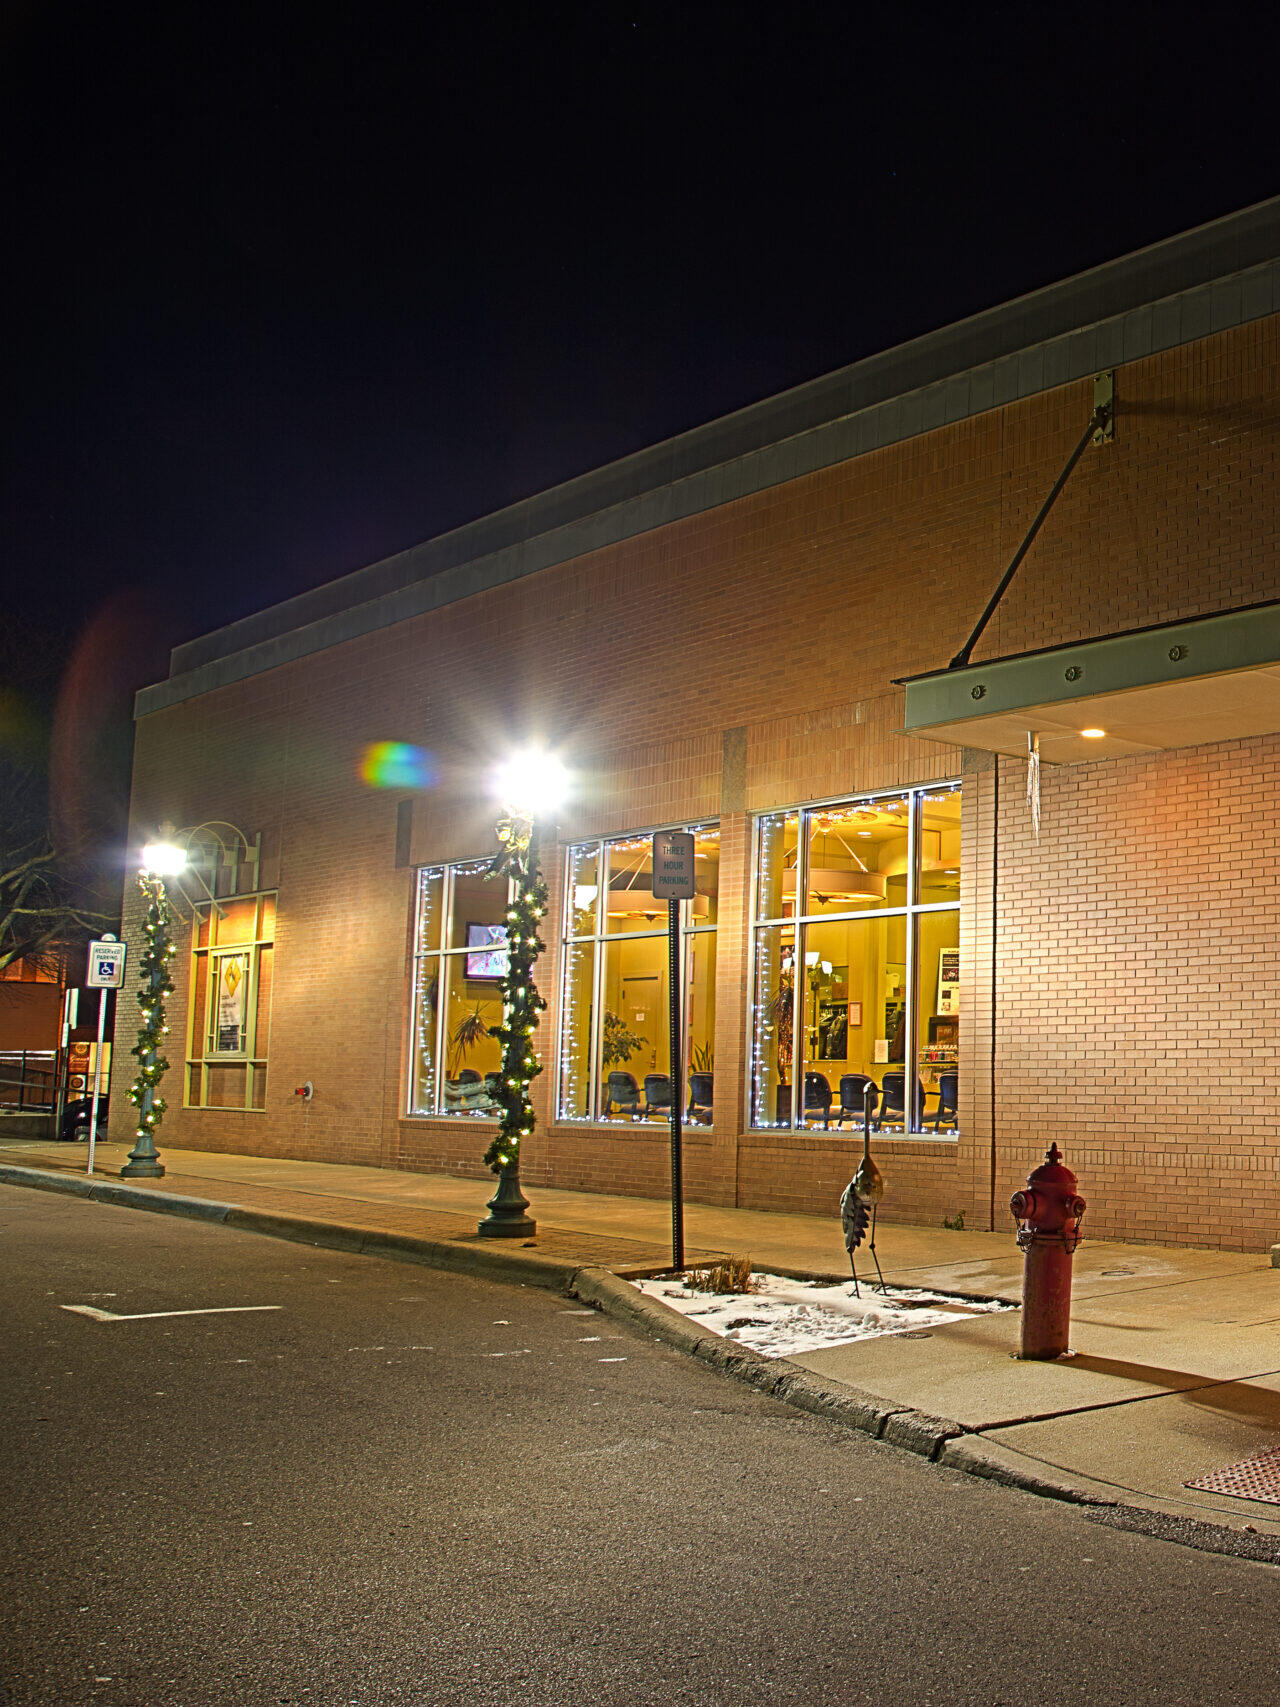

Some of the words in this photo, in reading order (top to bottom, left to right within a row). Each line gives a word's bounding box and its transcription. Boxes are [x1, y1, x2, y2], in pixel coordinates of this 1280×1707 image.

[662, 845, 685, 856] THREE
[663, 861, 684, 870] HOUR
[658, 875, 689, 885] PARKING
